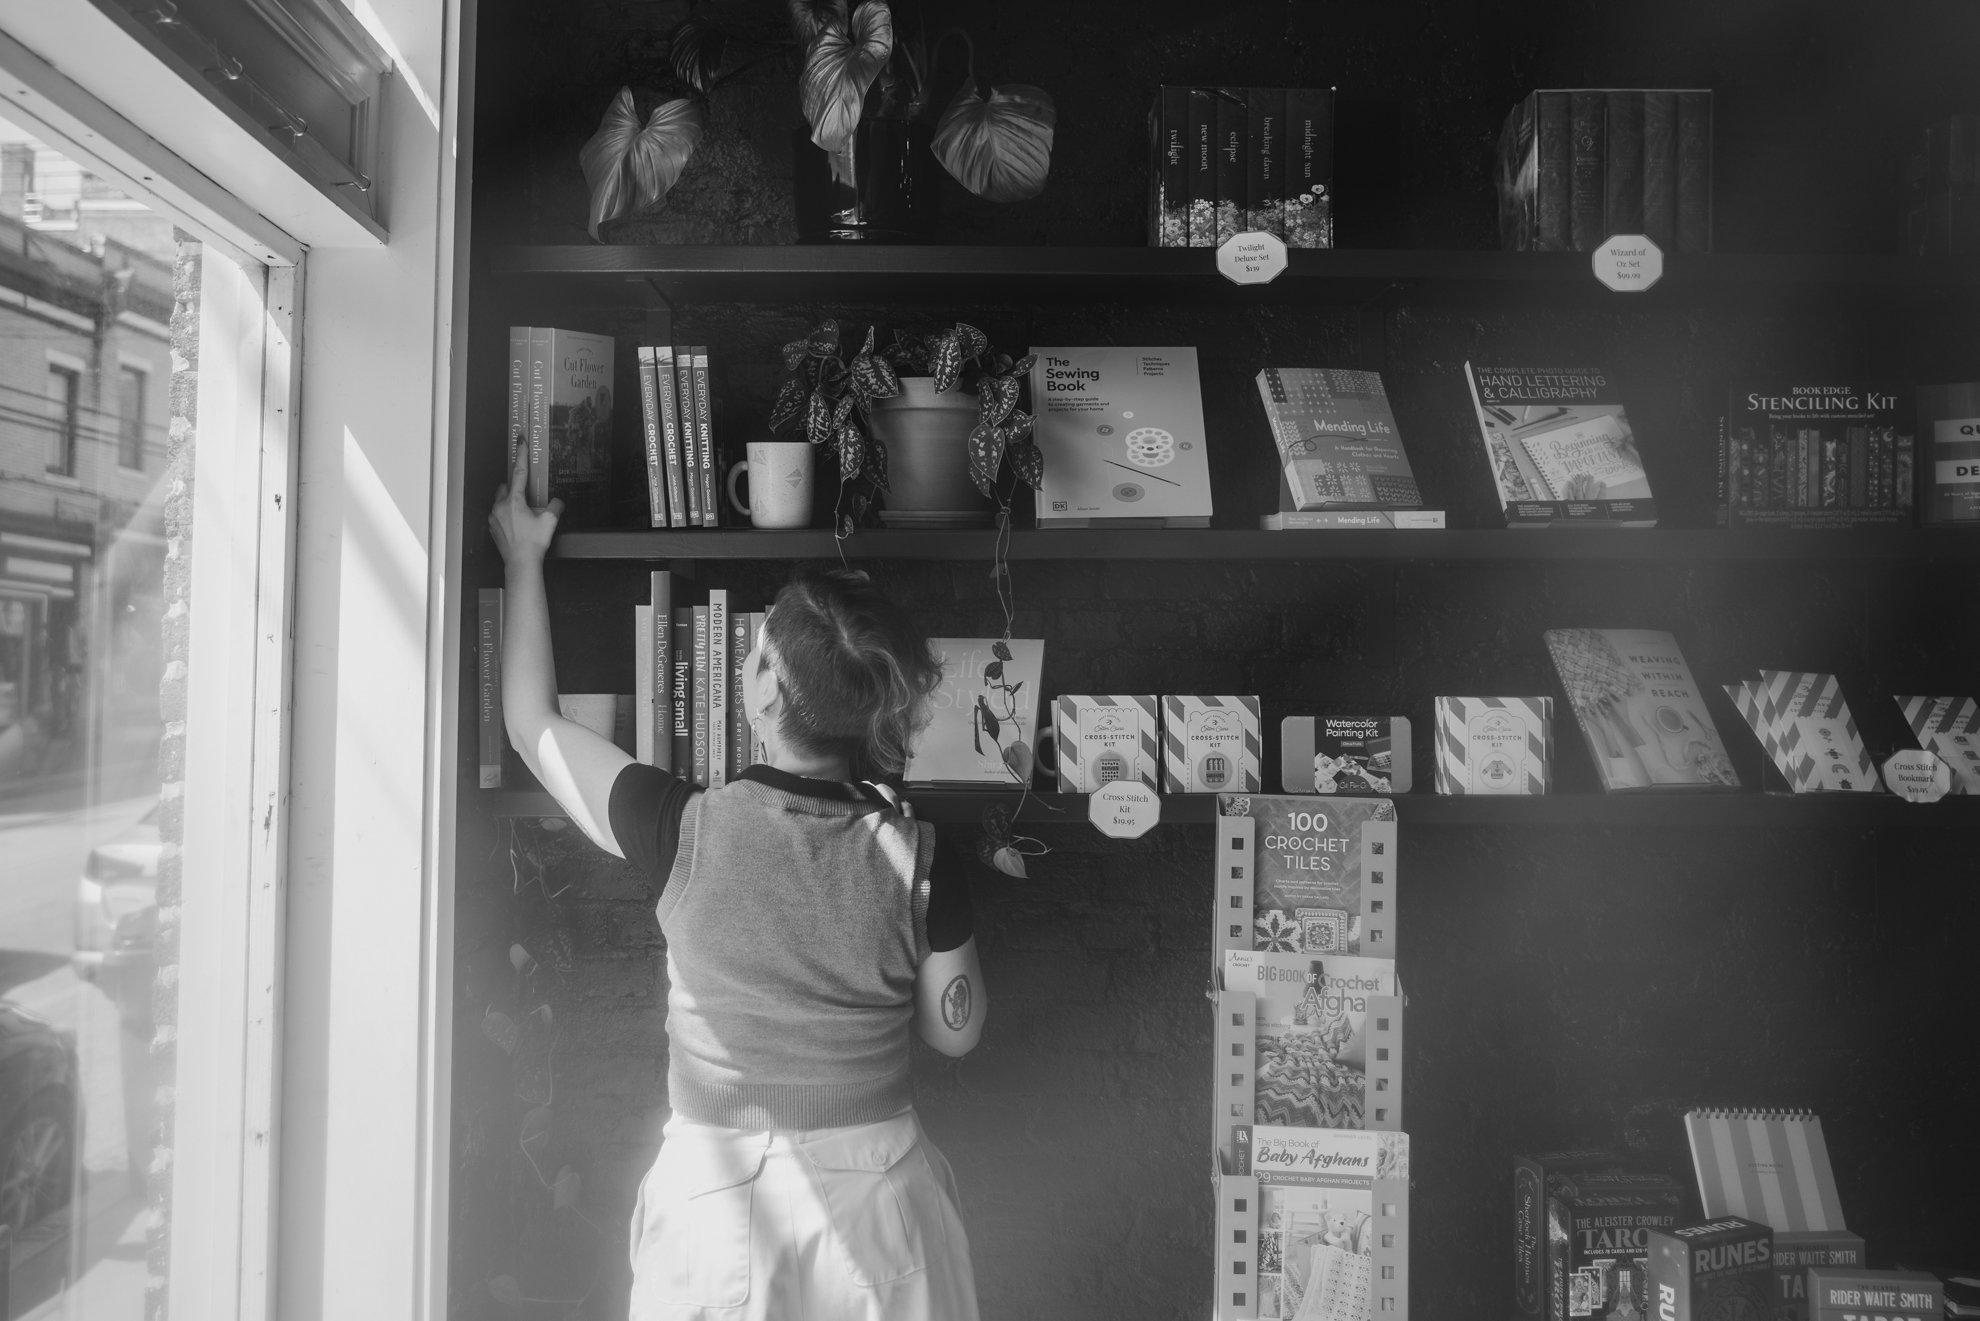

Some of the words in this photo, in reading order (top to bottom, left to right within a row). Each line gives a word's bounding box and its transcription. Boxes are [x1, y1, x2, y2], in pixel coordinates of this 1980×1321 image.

[1200, 124, 1208, 143] new
[1261, 117, 1272, 155] breaking
[1302, 119, 1317, 159] midnight
[1168, 129, 1184, 166] twilight
[1222, 131, 1239, 163] eclipse
[1199, 144, 1208, 171] moon
[1263, 157, 1272, 180] dawn
[1304, 162, 1312, 178] sun
[1238, 243, 1265, 252] Twilight
[1610, 248, 1637, 256] Wizard
[1638, 248, 1646, 256] of
[1234, 255, 1258, 263] Deluxe
[1258, 253, 1269, 261] Set
[1616, 260, 1627, 268] Oz
[1628, 260, 1641, 268] Set
[1616, 271, 1641, 280] $99.99
[511, 360, 522, 379] Cut
[533, 360, 543, 380] Cut
[564, 356, 578, 372] Cut
[579, 358, 605, 374] Flower
[1046, 357, 1070, 367] The
[570, 374, 597, 390] Garden
[1046, 368, 1100, 381] Sewing
[1479, 375, 1523, 387] HAND
[1525, 375, 1606, 387] LETTERING
[680, 369, 691, 419] EVERYDAY
[696, 370, 708, 421] EVERYDAY
[1046, 380, 1086, 392] Book
[1484, 387, 1494, 399] &
[1498, 387, 1597, 399] CALLIGRAPHY
[1792, 386, 1822, 395] BOOK
[1823, 386, 1852, 395] EDGE
[511, 382, 522, 421] Flower
[533, 384, 543, 422] Flower
[643, 375, 655, 422] EVERYDAY
[661, 374, 673, 420] EVERYDAY
[1747, 393, 1859, 410] STENCILING
[1867, 393, 1898, 410] KIT
[1313, 419, 1367, 436] Mending
[1367, 421, 1391, 434] Life
[532, 425, 543, 464] Garden
[647, 423, 658, 466] CROCHET
[665, 422, 677, 466] CROCHET
[684, 422, 695, 468] KNITTING
[700, 423, 711, 469] KNITTING
[1337, 516, 1366, 525] Mending
[1366, 516, 1381, 524] Life
[482, 620, 493, 639] Cut
[657, 614, 667, 639] Ellen
[694, 614, 706, 649] PRETTY
[712, 603, 723, 645] MODERN
[482, 643, 493, 681] Flower
[656, 640, 667, 694] DeGeneres
[695, 651, 706, 673] FUN
[1628, 655, 1681, 665] WEAVING
[672, 662, 688, 698] living
[712, 650, 723, 709] AMERICANA
[1640, 672, 1684, 681] WITHIN
[695, 677, 705, 708] KATE
[1651, 689, 1689, 698] REACH
[483, 683, 493, 723] Garden
[657, 704, 667, 735] Home
[675, 700, 688, 737] small
[1325, 719, 1378, 728] Watercolor
[695, 713, 705, 766] HUDSON
[1326, 728, 1364, 739] Painting
[1365, 728, 1379, 737] Kit
[1894, 762, 1915, 770] Cross
[1915, 763, 1938, 771] Stitch
[1898, 774, 1935, 783] Bookmark
[1102, 793, 1125, 802] Cross
[1126, 793, 1149, 803] Stitch
[1119, 805, 1131, 814] Kit
[1112, 816, 1135, 826] $19.95
[1287, 812, 1328, 832] 100
[1264, 835, 1350, 853] CROCHET
[1283, 855, 1331, 871] TILES
[1257, 965, 1277, 981] BIG
[1278, 968, 1306, 983] BOOK
[1306, 973, 1318, 984] OF
[1317, 973, 1380, 991] Crochet
[1257, 1137, 1272, 1146] The
[1273, 1138, 1287, 1148] Big
[1288, 1139, 1310, 1148] Book
[1311, 1140, 1320, 1148] of
[1256, 1146, 1298, 1167] Baby
[1300, 1148, 1370, 1169] Afghans
[1256, 1171, 1271, 1183] 29
[1341, 1178, 1370, 1186] PROJECTS
[1524, 1194, 1532, 1240] Sherlock
[1576, 1217, 1592, 1230] THE
[1594, 1216, 1633, 1228] ALEISTER
[1636, 1215, 1674, 1226] CROWLEY
[1674, 1220, 1749, 1238] RUNES
[1524, 1243, 1532, 1284] Holmes
[1695, 1237, 1770, 1274] RUNES
[1798, 1250, 1826, 1265] WAITE
[1829, 1250, 1857, 1265] SMITH
[1830, 1289, 1861, 1306] RIDER
[1864, 1291, 1897, 1307] WAITE
[1900, 1292, 1933, 1309] SMITH
